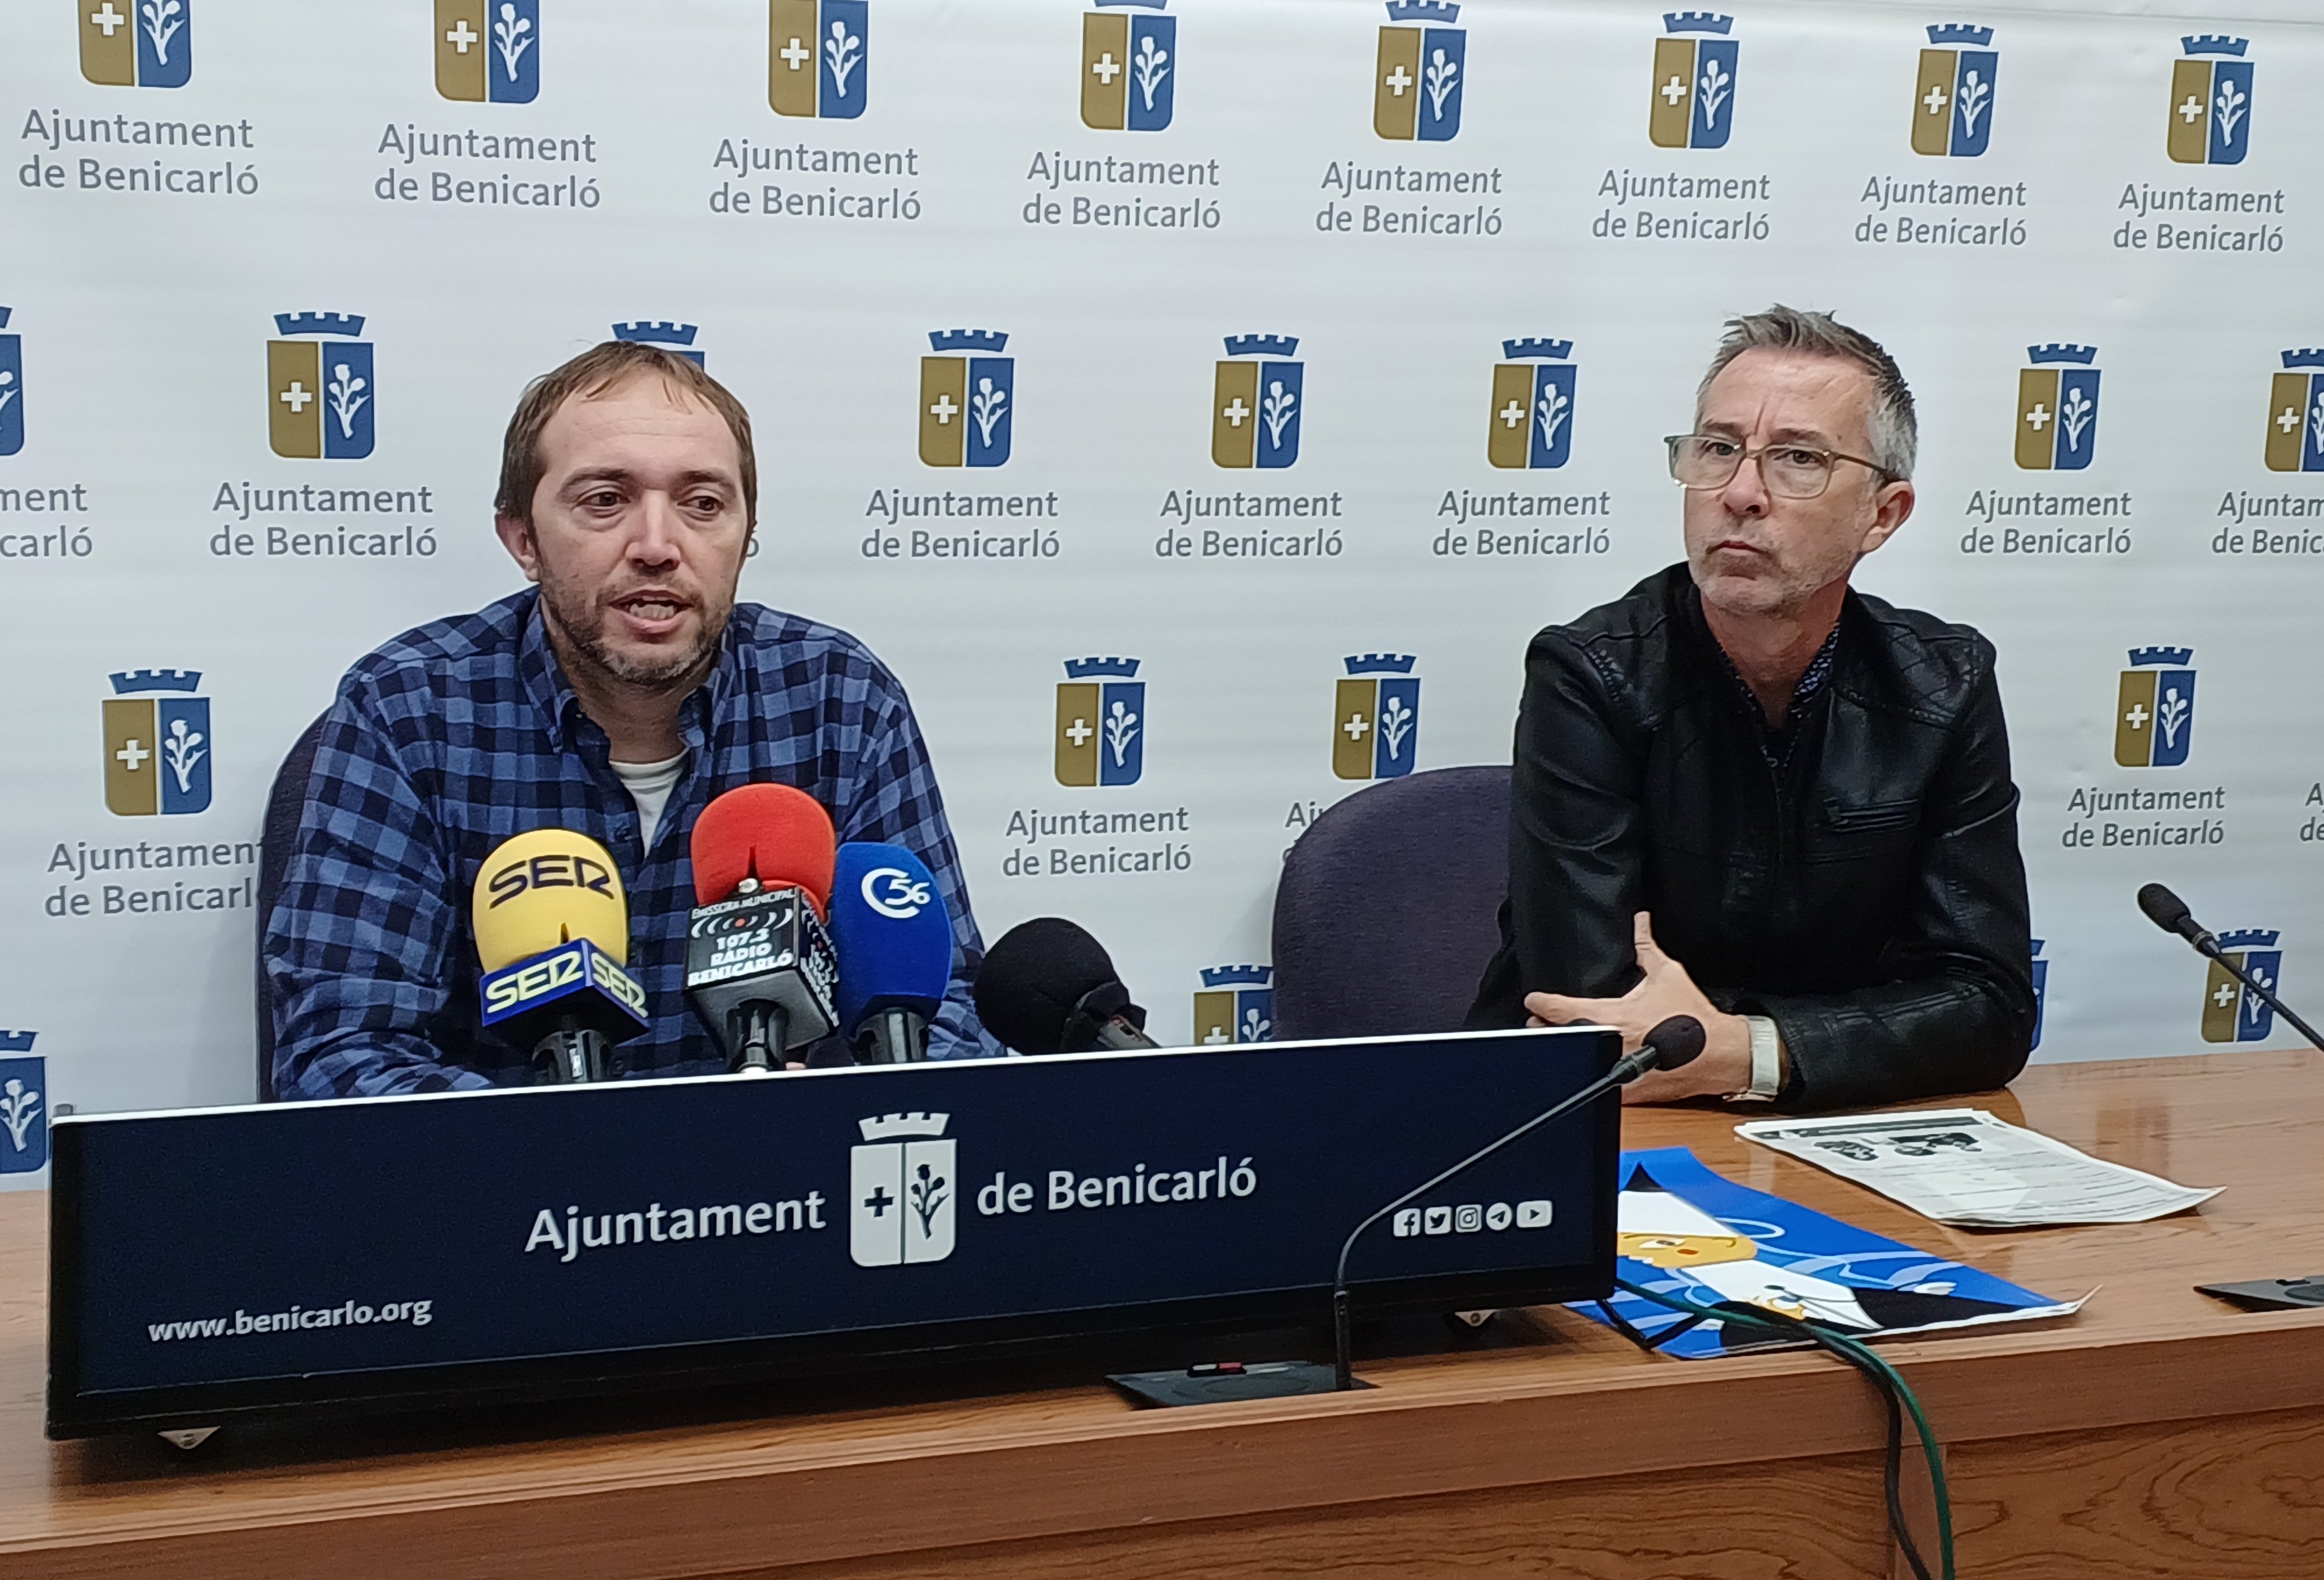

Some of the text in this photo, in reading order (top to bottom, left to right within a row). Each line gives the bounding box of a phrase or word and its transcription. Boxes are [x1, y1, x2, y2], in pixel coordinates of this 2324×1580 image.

[21, 109, 253, 150] Ajuntament
[378, 124, 596, 164] Ajuntament
[20, 155, 257, 194] de Benicarló
[713, 139, 918, 178] Ajuntament
[1027, 152, 1219, 189] Ajuntament
[375, 168, 600, 207] de Benicarló
[1321, 161, 1501, 198] Ajuntament
[1598, 170, 1770, 205] Ajuntament
[1861, 176, 2026, 211] Ajuntament
[710, 182, 920, 219] de Benicarló
[1024, 193, 1220, 228] de Benicarló
[2119, 184, 2284, 217] Ajuntament
[1317, 202, 1501, 235] de Benicarló
[1593, 209, 1769, 240] de Benicarló
[1856, 214, 2025, 245] de Benicarló
[2114, 221, 2282, 252] de Benicarló
[213, 482, 432, 520] Ajuntament
[866, 489, 1057, 525] Ajuntament
[1160, 490, 1342, 525] Ajuntament
[1438, 490, 1610, 524] Ajuntament
[1966, 490, 2131, 523] Ajuntament
[211, 525, 436, 555] de Benicarló
[862, 529, 1059, 557] de Benicarló
[1156, 529, 1342, 556] de Benicarló
[1433, 527, 1609, 555] de Benicarló
[1961, 527, 2131, 553] de Benicarló
[2212, 527, 2324, 554] de Benic
[2068, 787, 2225, 818] Ajuntament
[1006, 807, 1188, 843] Ajuntament
[2063, 820, 2223, 847] de Benicarló
[48, 842, 264, 881] Ajuntamen
[1003, 843, 1190, 876] de Benicarló
[45, 877, 252, 917] de Benicarl
[489, 854, 615, 910] SER
[486, 951, 583, 1014] SER
[525, 1156, 1257, 1262] Ajuntament de Benicarló
[148, 1300, 432, 1342] www.benicarlo.org
